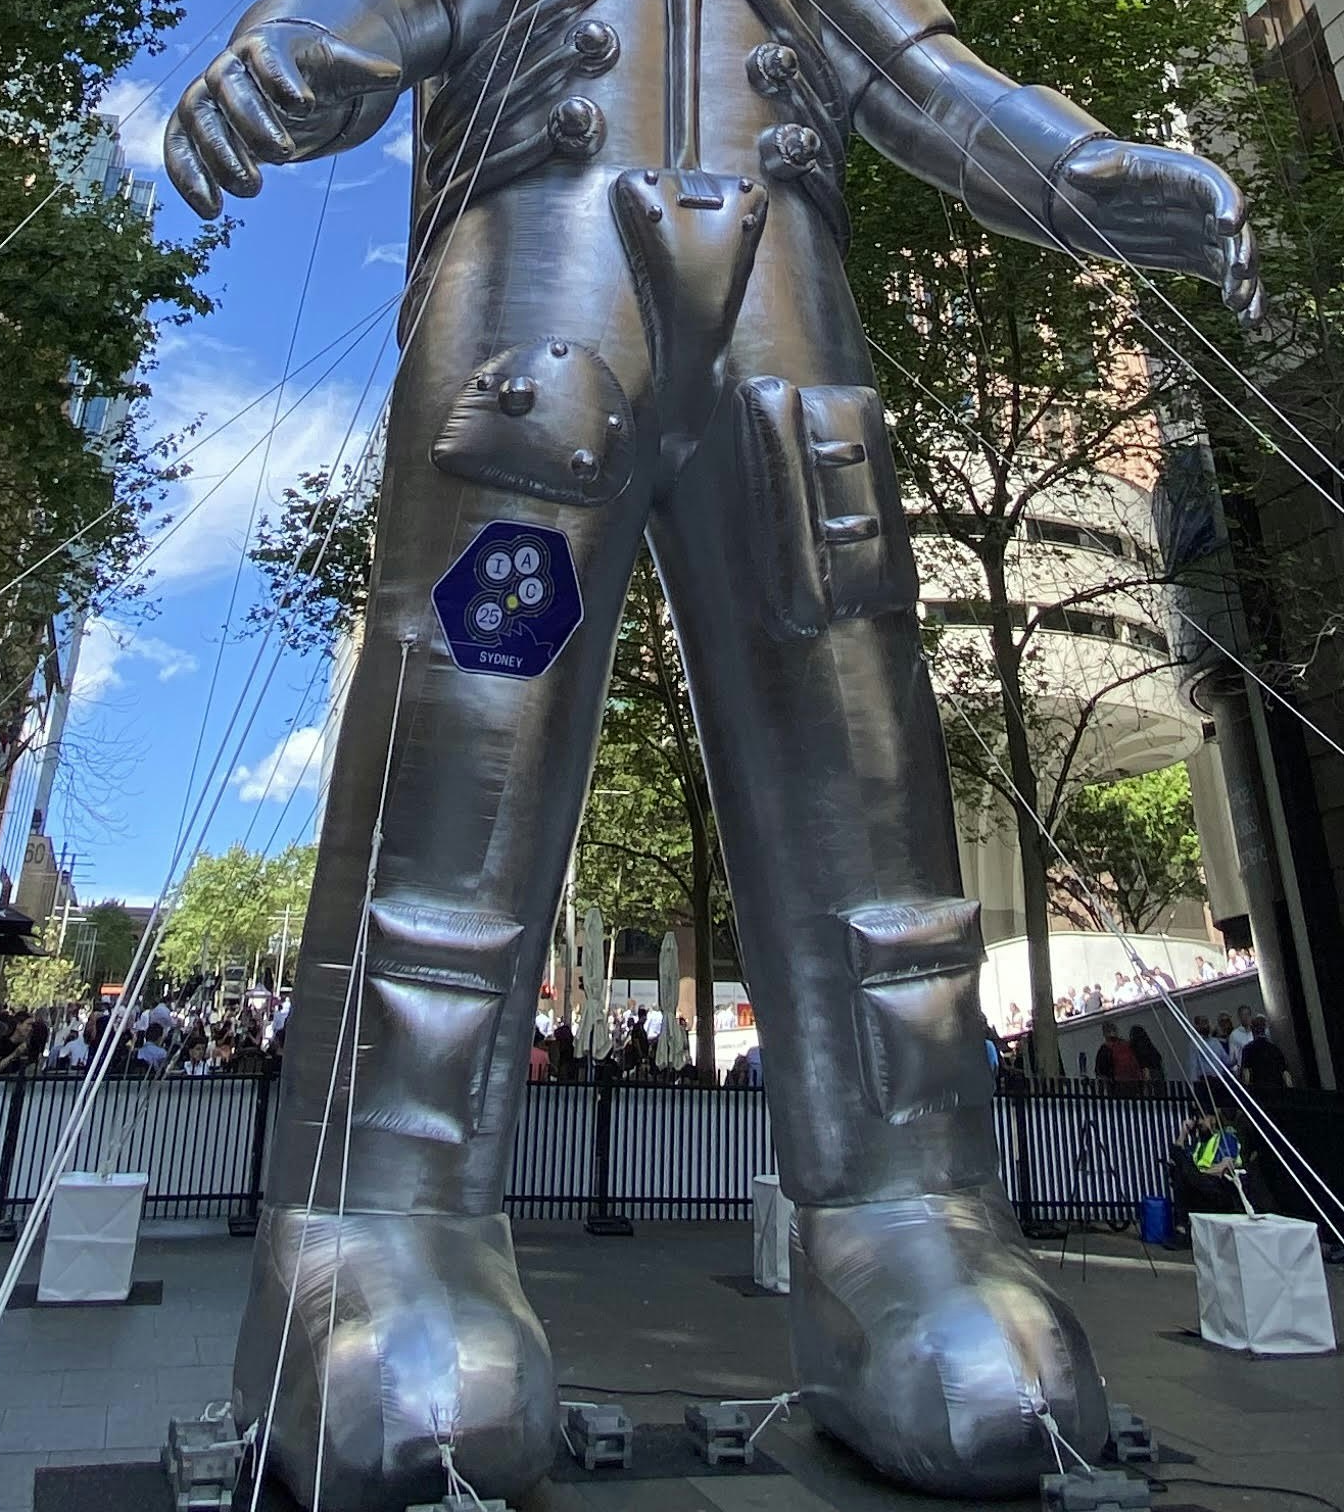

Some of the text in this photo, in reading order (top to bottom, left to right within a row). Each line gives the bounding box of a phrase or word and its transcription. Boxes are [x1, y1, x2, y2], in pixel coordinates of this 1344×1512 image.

[490, 551, 532, 575] I A
[524, 582, 537, 599] C
[478, 607, 500, 625] 25
[479, 649, 524, 669] SYDNEY
